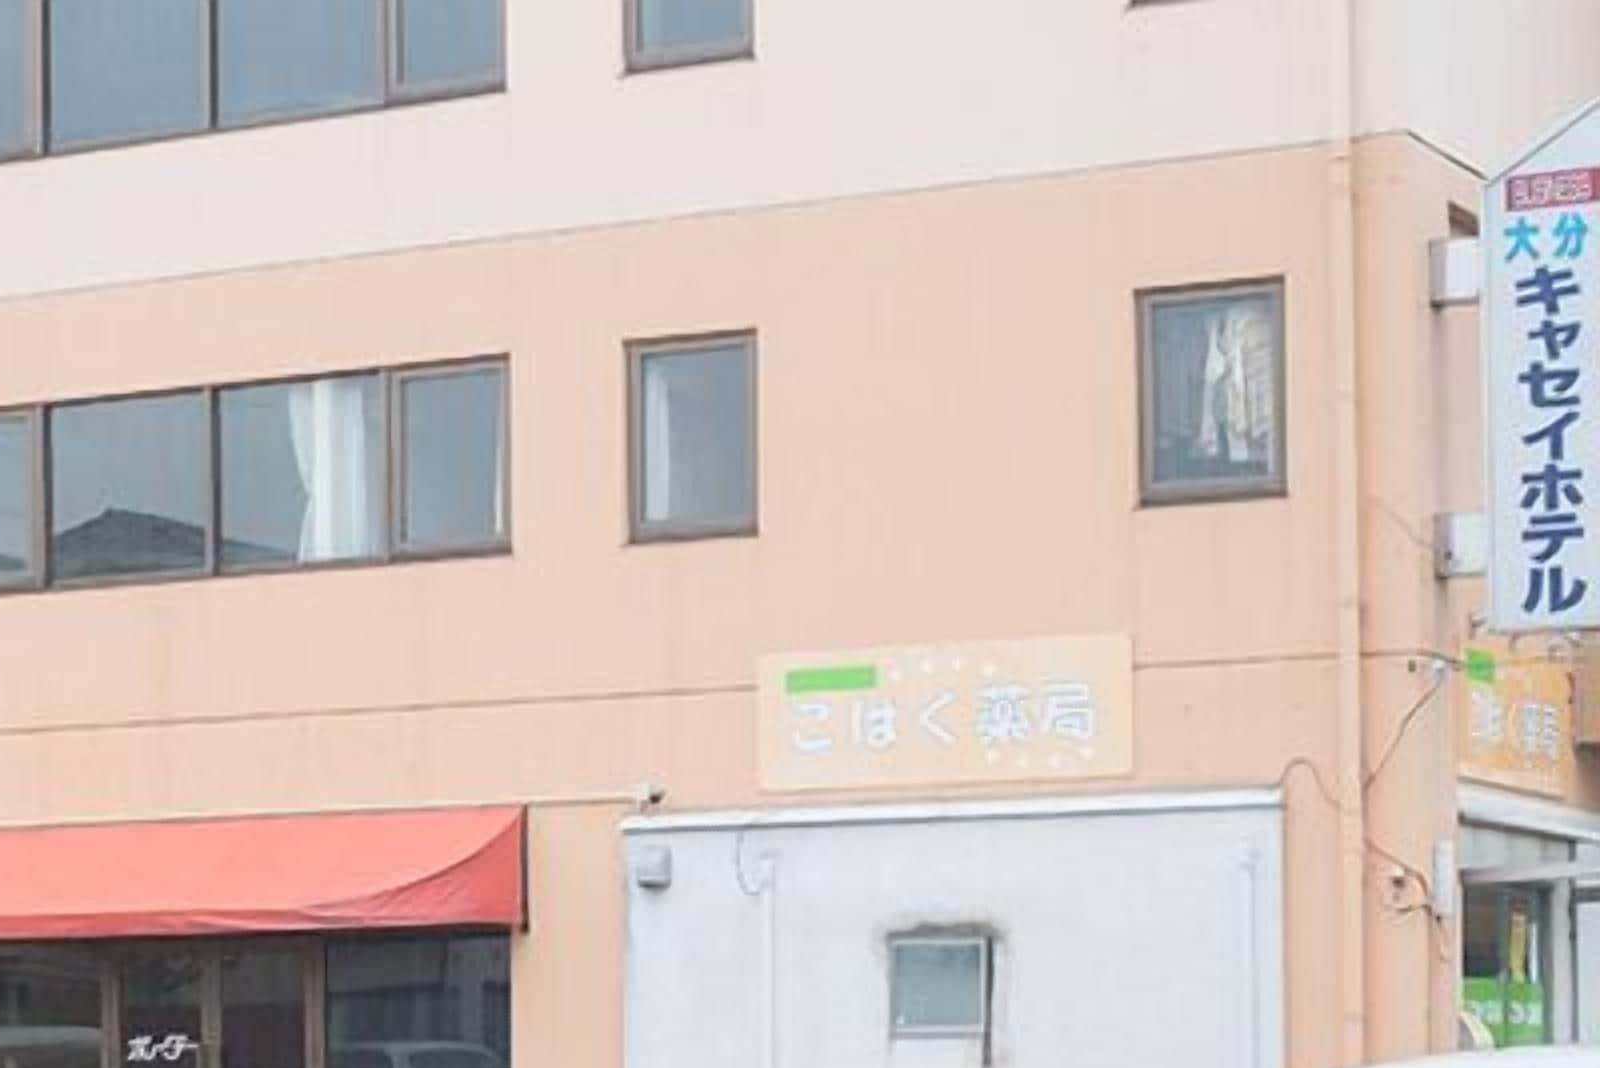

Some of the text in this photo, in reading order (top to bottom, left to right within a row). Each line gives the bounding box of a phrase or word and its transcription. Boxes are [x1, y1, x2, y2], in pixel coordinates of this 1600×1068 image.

[1504, 212, 1589, 262] 大分
[1515, 266, 1587, 613] キャセイホテル
